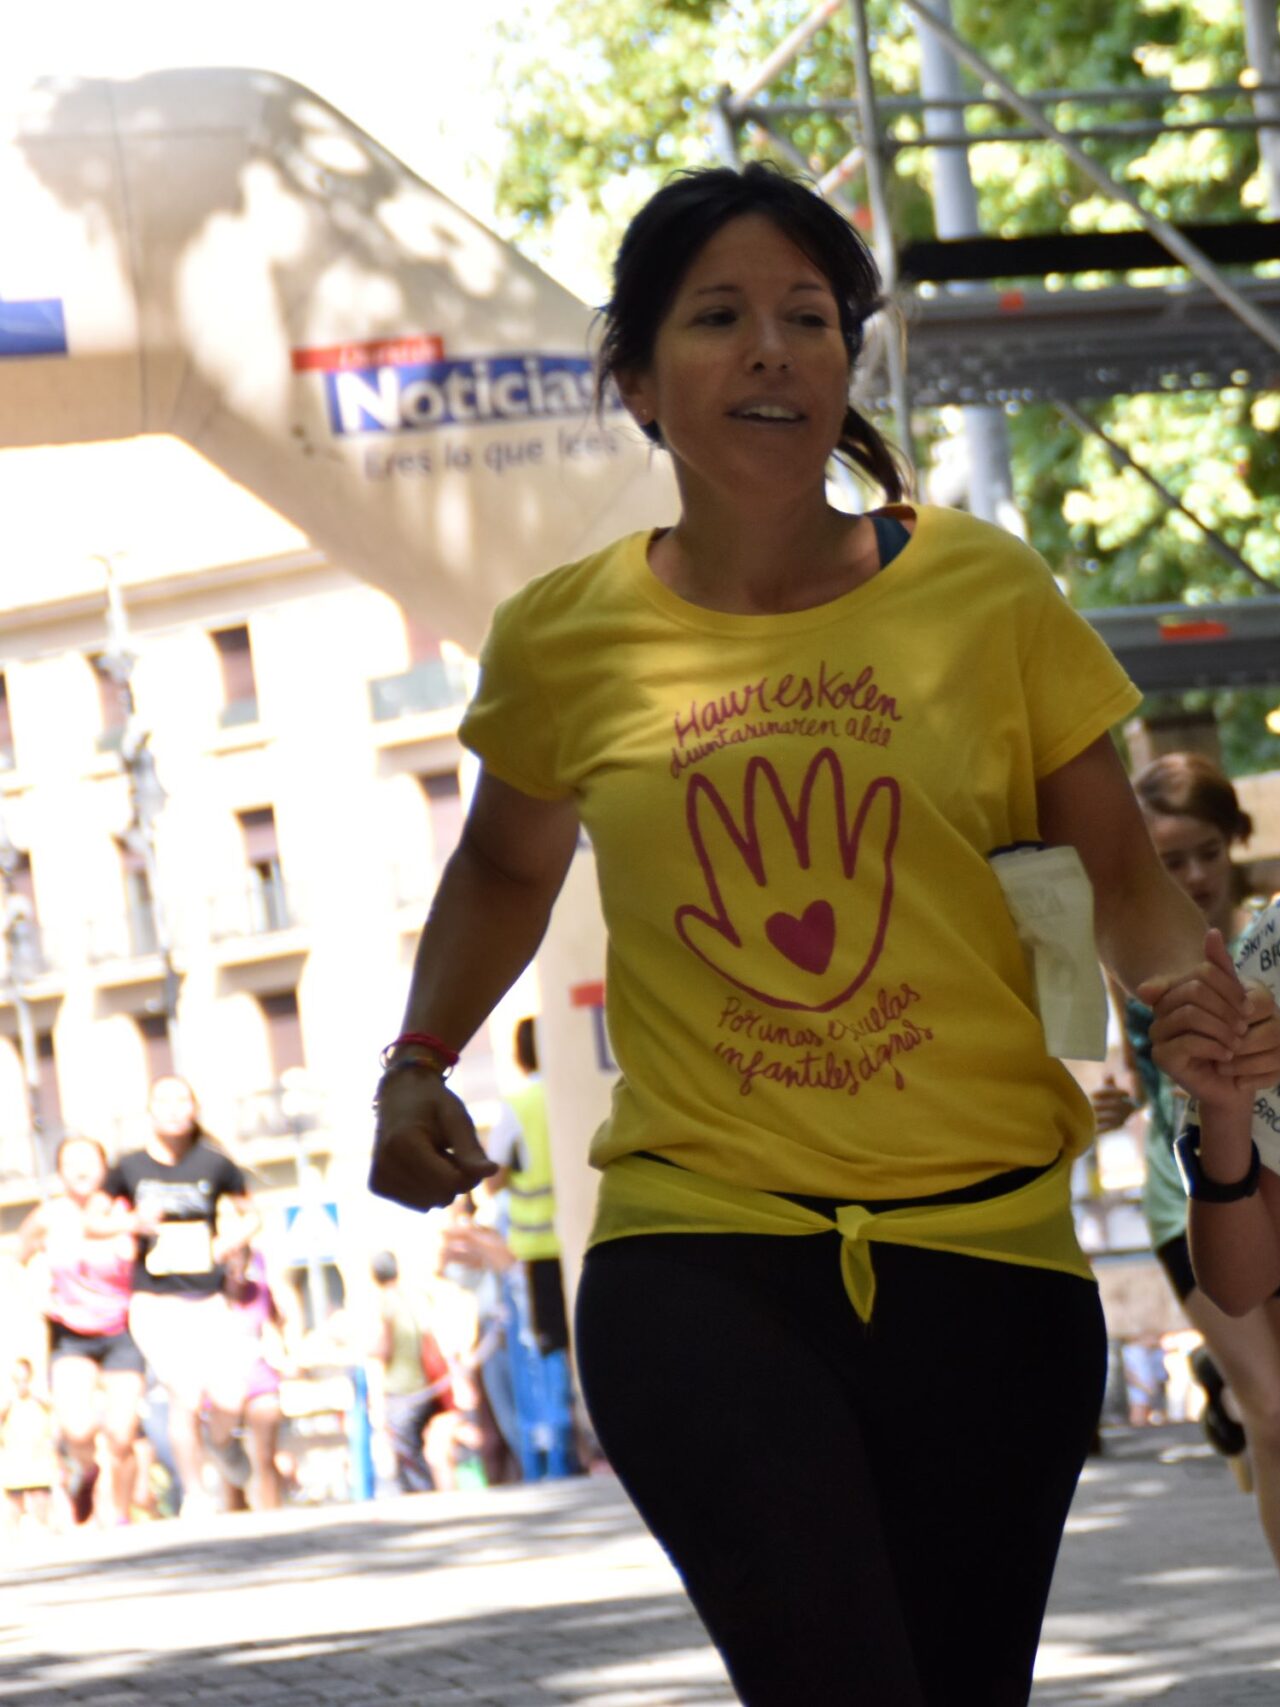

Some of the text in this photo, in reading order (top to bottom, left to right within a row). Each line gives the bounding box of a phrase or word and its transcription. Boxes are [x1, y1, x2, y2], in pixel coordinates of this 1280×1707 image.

[445, 445, 472, 469] lo
[484, 439, 544, 475] que
[845, 714, 893, 749] alde
[717, 996, 762, 1038] Por
[758, 1022, 824, 1047] unas
[714, 1037, 859, 1096] infantiles
